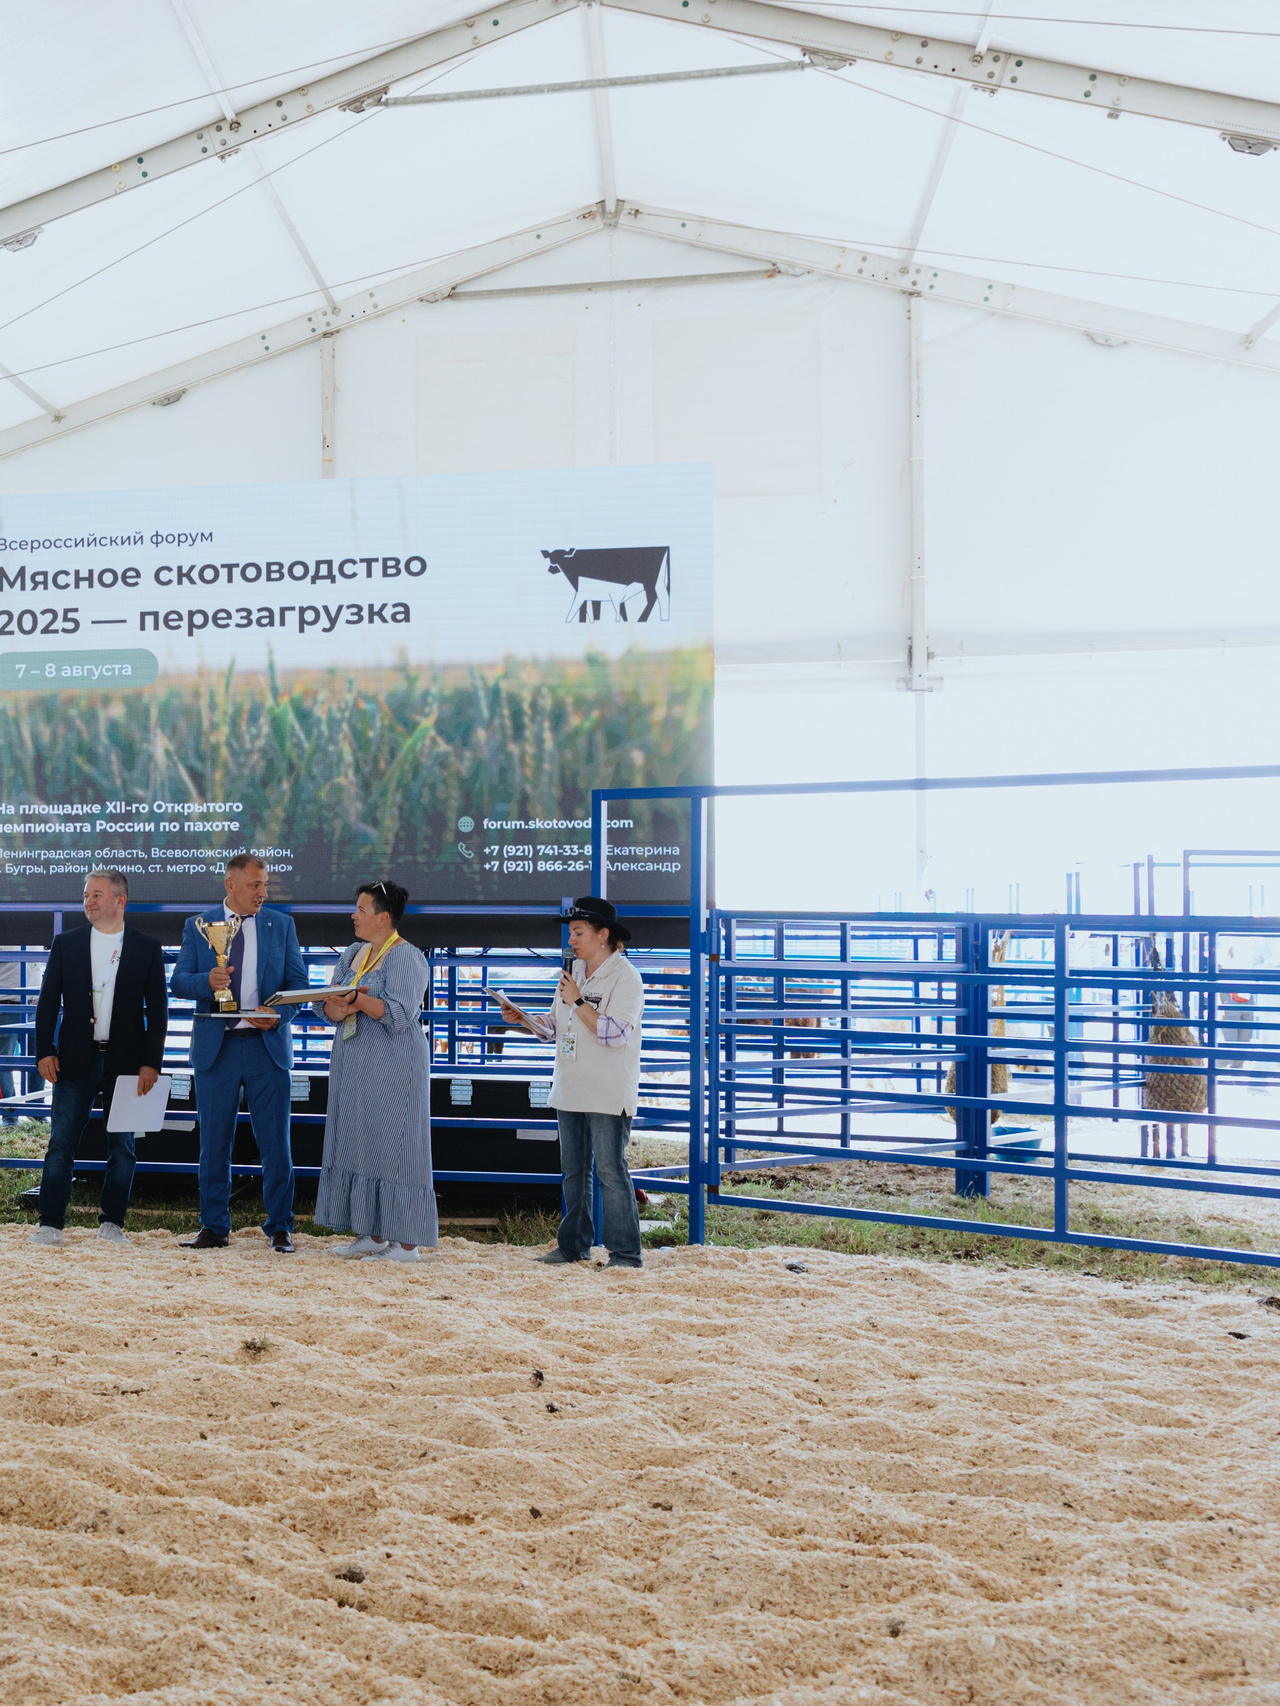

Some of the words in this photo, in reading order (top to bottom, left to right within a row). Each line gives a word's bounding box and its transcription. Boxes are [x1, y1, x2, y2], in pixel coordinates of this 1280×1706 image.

[150, 530, 214, 548] форум
[154, 555, 428, 587] скотоводство
[139, 601, 412, 637] перезагрузка
[15, 664, 27, 679] 7
[44, 663, 57, 678] 8
[61, 663, 132, 680] августа
[19, 803, 102, 816] площадке
[105, 801, 150, 814] XII-го
[153, 800, 244, 816] Открытого
[95, 820, 155, 833] России
[159, 821, 180, 832] по
[184, 820, 240, 832] пахоте
[94, 847, 148, 859] область,
[151, 846, 246, 858] Всеволожский
[483, 845, 500, 856] +7
[503, 844, 534, 858] (921)
[536, 844, 592, 856] 741-33-8
[606, 844, 680, 858] Екатерина
[5, 862, 46, 876] Бугры,
[49, 862, 89, 876] район
[148, 864, 164, 873] ст.
[166, 863, 207, 875] метро
[483, 861, 500, 872] +7
[503, 860, 534, 874] (921)
[536, 860, 592, 872] 866-26-1
[606, 860, 682, 874] Александр
